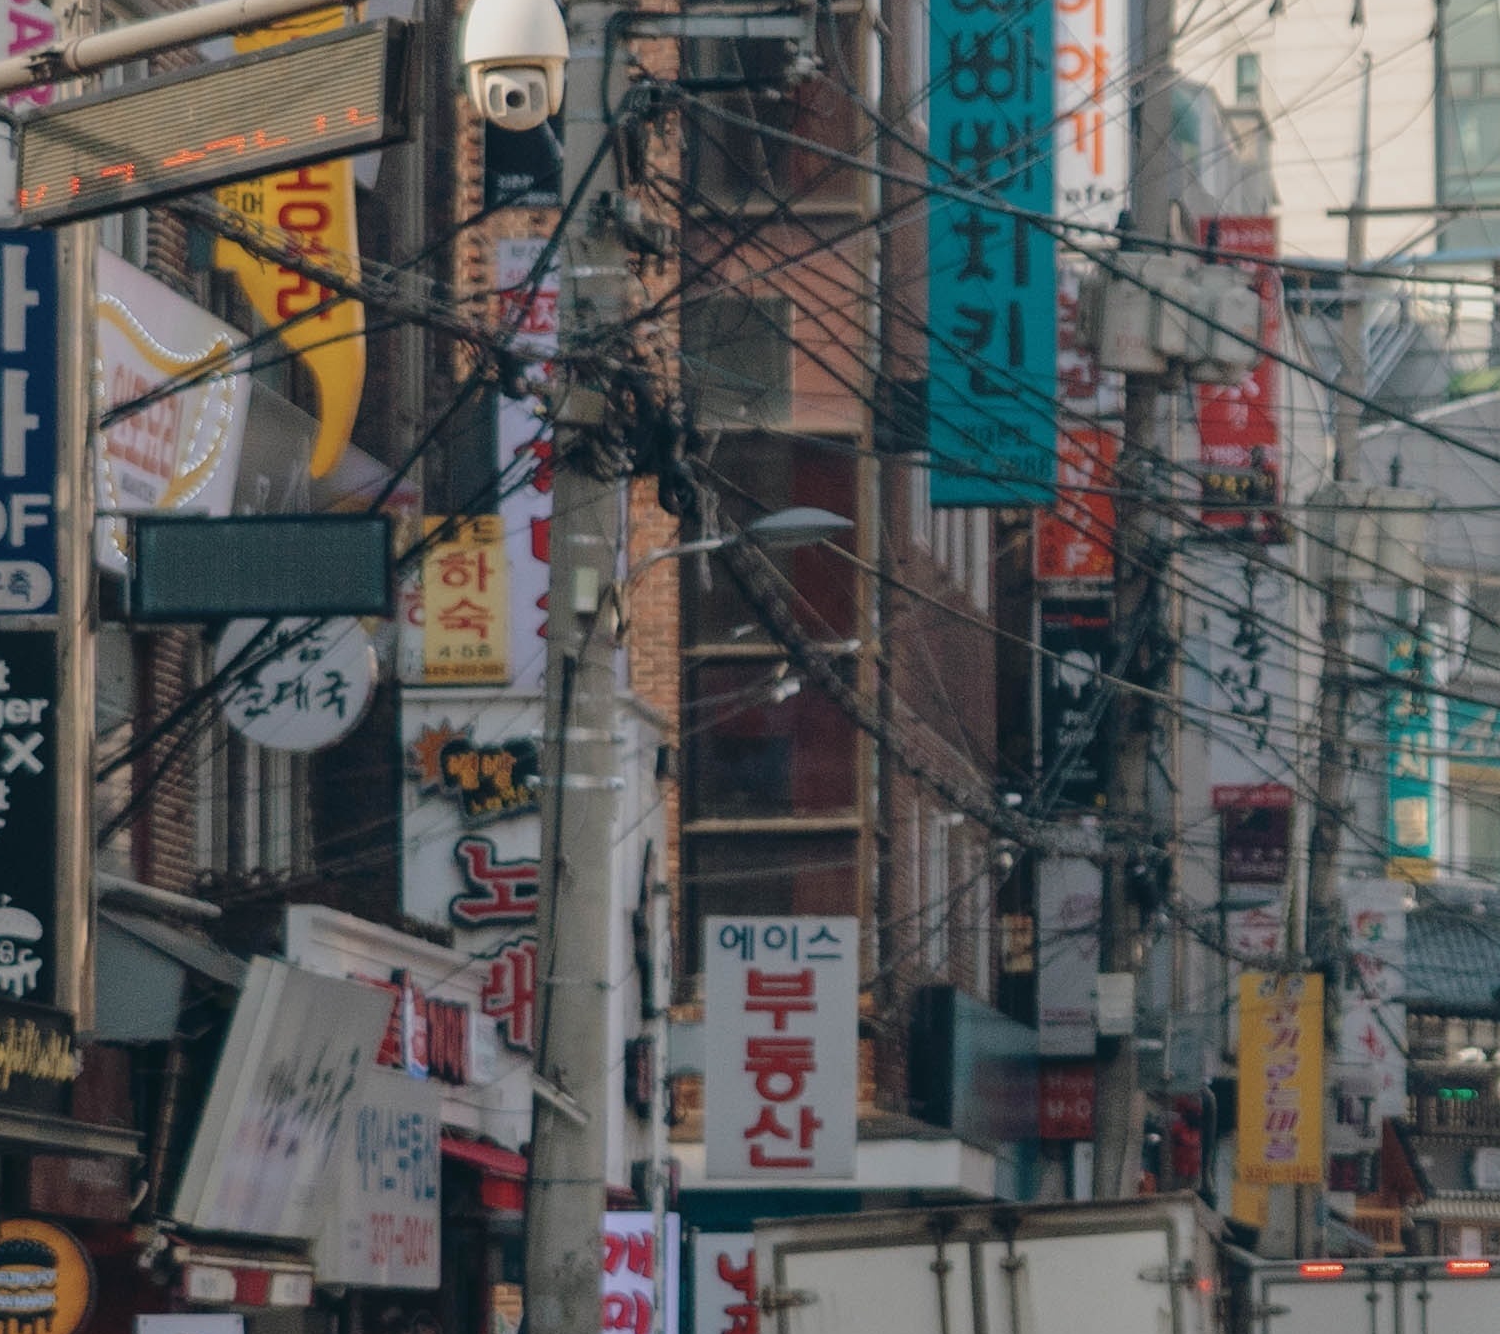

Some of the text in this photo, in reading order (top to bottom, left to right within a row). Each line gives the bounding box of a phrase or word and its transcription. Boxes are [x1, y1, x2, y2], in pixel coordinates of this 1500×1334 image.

[437, 550, 496, 641] 하숙
[717, 923, 845, 961] 에이스
[743, 969, 824, 1170] 부동산
